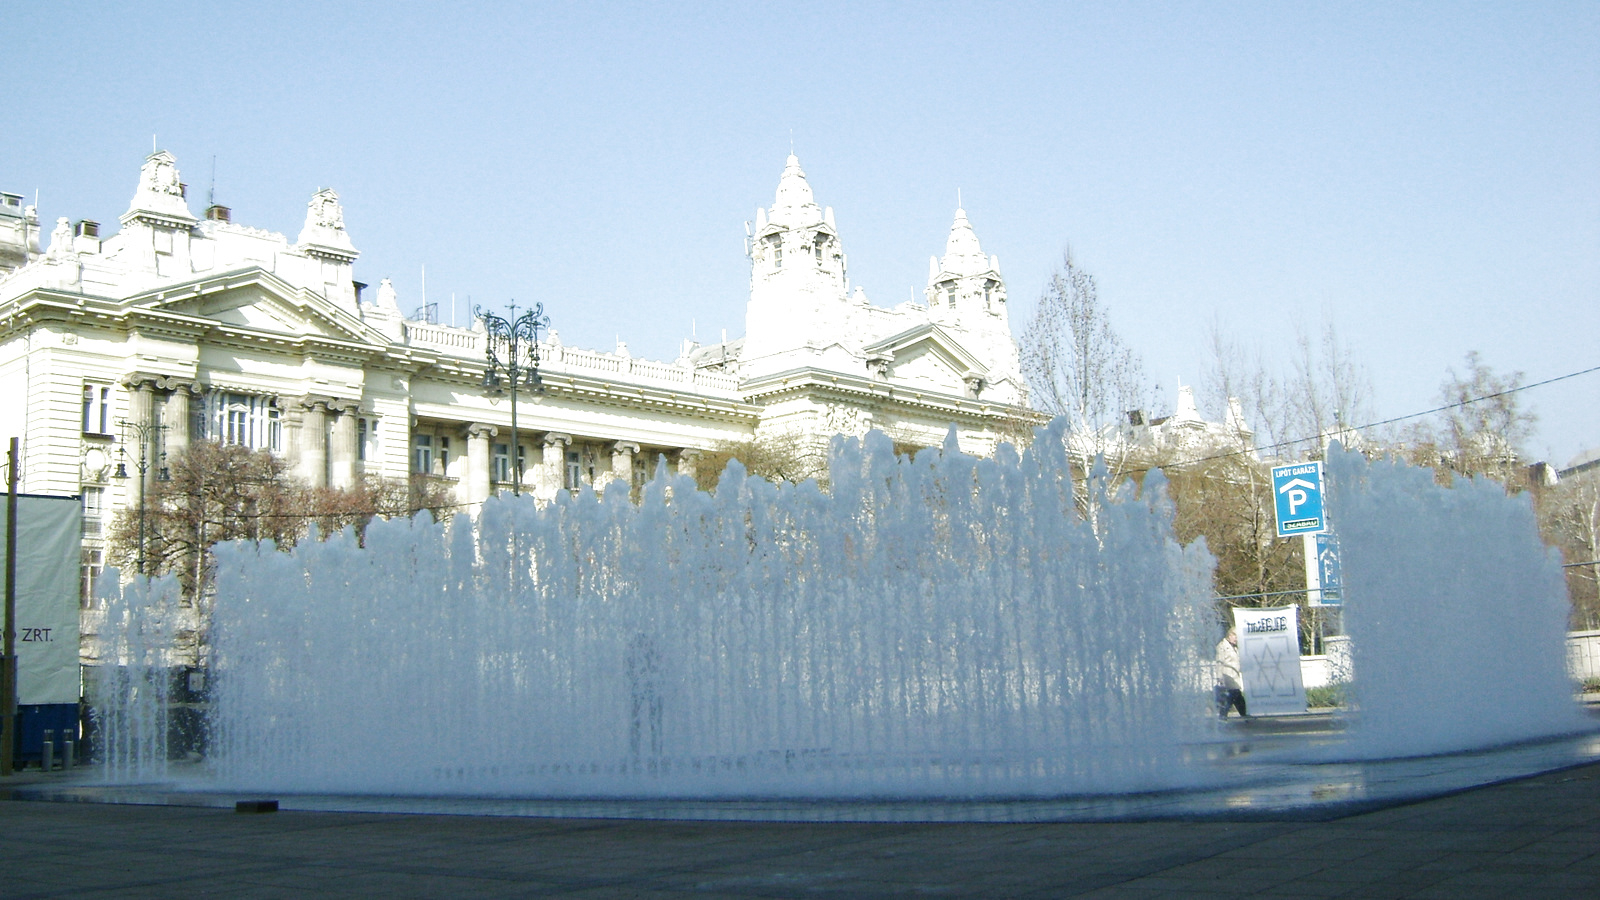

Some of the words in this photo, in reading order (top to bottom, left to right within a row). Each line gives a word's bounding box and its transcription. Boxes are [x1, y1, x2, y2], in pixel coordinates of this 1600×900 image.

[1275, 468, 1291, 477] LIPÓT
[1292, 465, 1316, 476] GARÁZS
[1288, 489, 1307, 515] P
[22, 628, 53, 641] ZRT.
